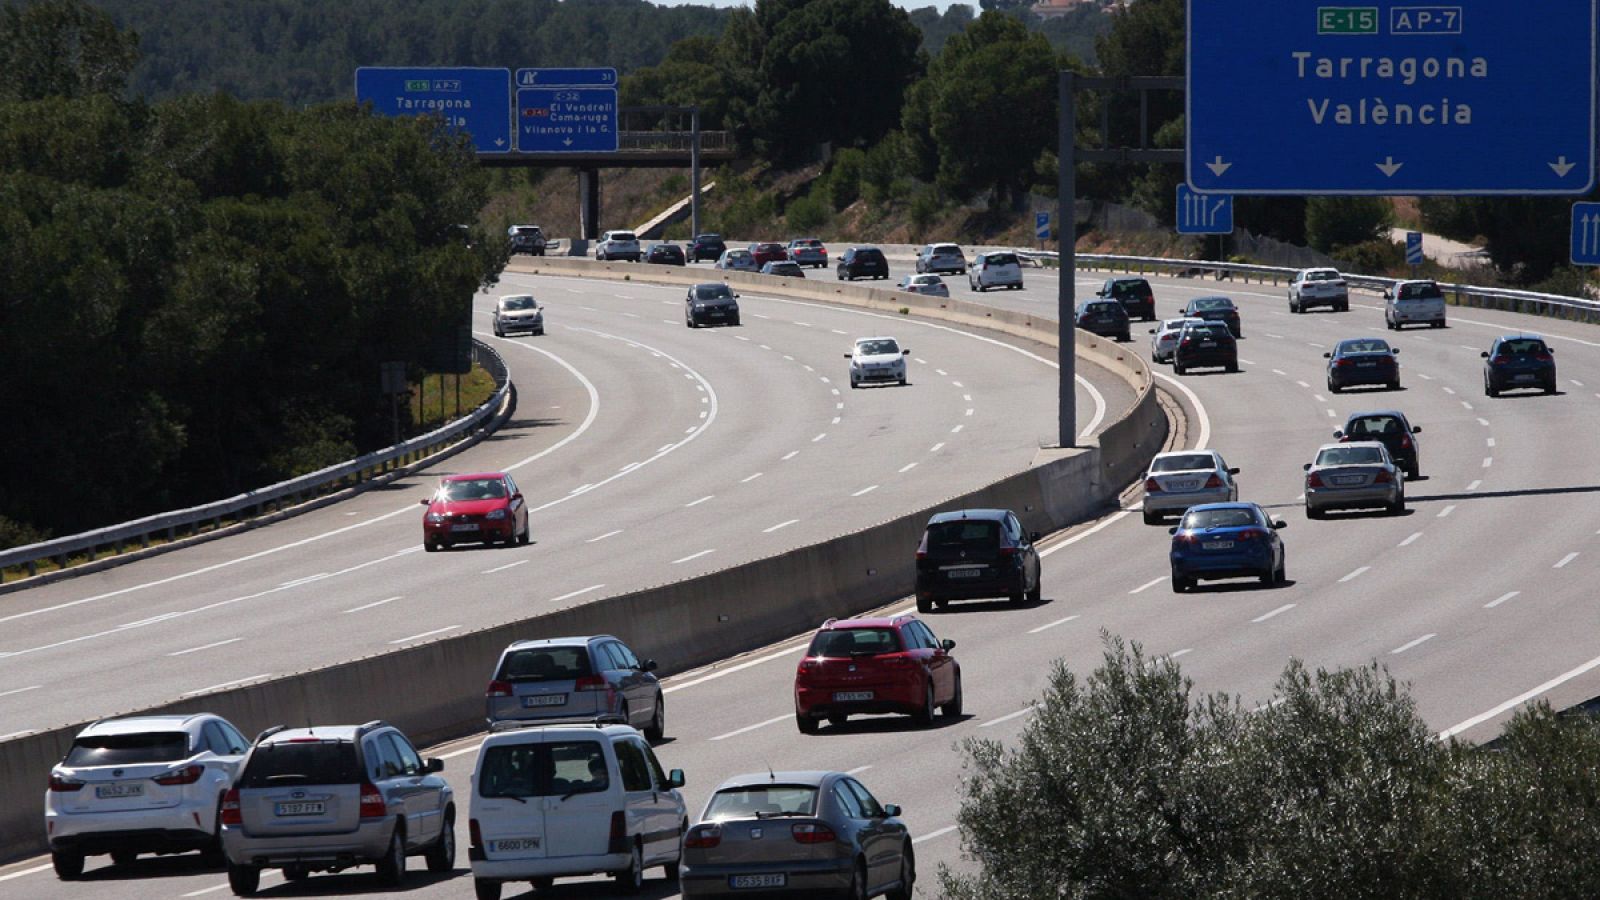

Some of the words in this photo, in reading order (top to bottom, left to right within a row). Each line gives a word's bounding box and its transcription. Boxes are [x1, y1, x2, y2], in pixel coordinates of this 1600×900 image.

[1321, 11, 1374, 30] E-15
[1395, 11, 1458, 30] AP-7
[1292, 51, 1489, 85] Tarragona
[601, 73, 612, 81] 31
[435, 82, 459, 90] AP-7
[396, 97, 472, 112] Tarragona
[550, 103, 561, 112] El
[565, 103, 613, 112] Vendrell
[1307, 97, 1473, 126] València
[550, 113, 609, 123] Coma-ruga
[524, 125, 573, 134] Vilanova
[585, 125, 597, 133] la
[497, 840, 521, 851] 6600
